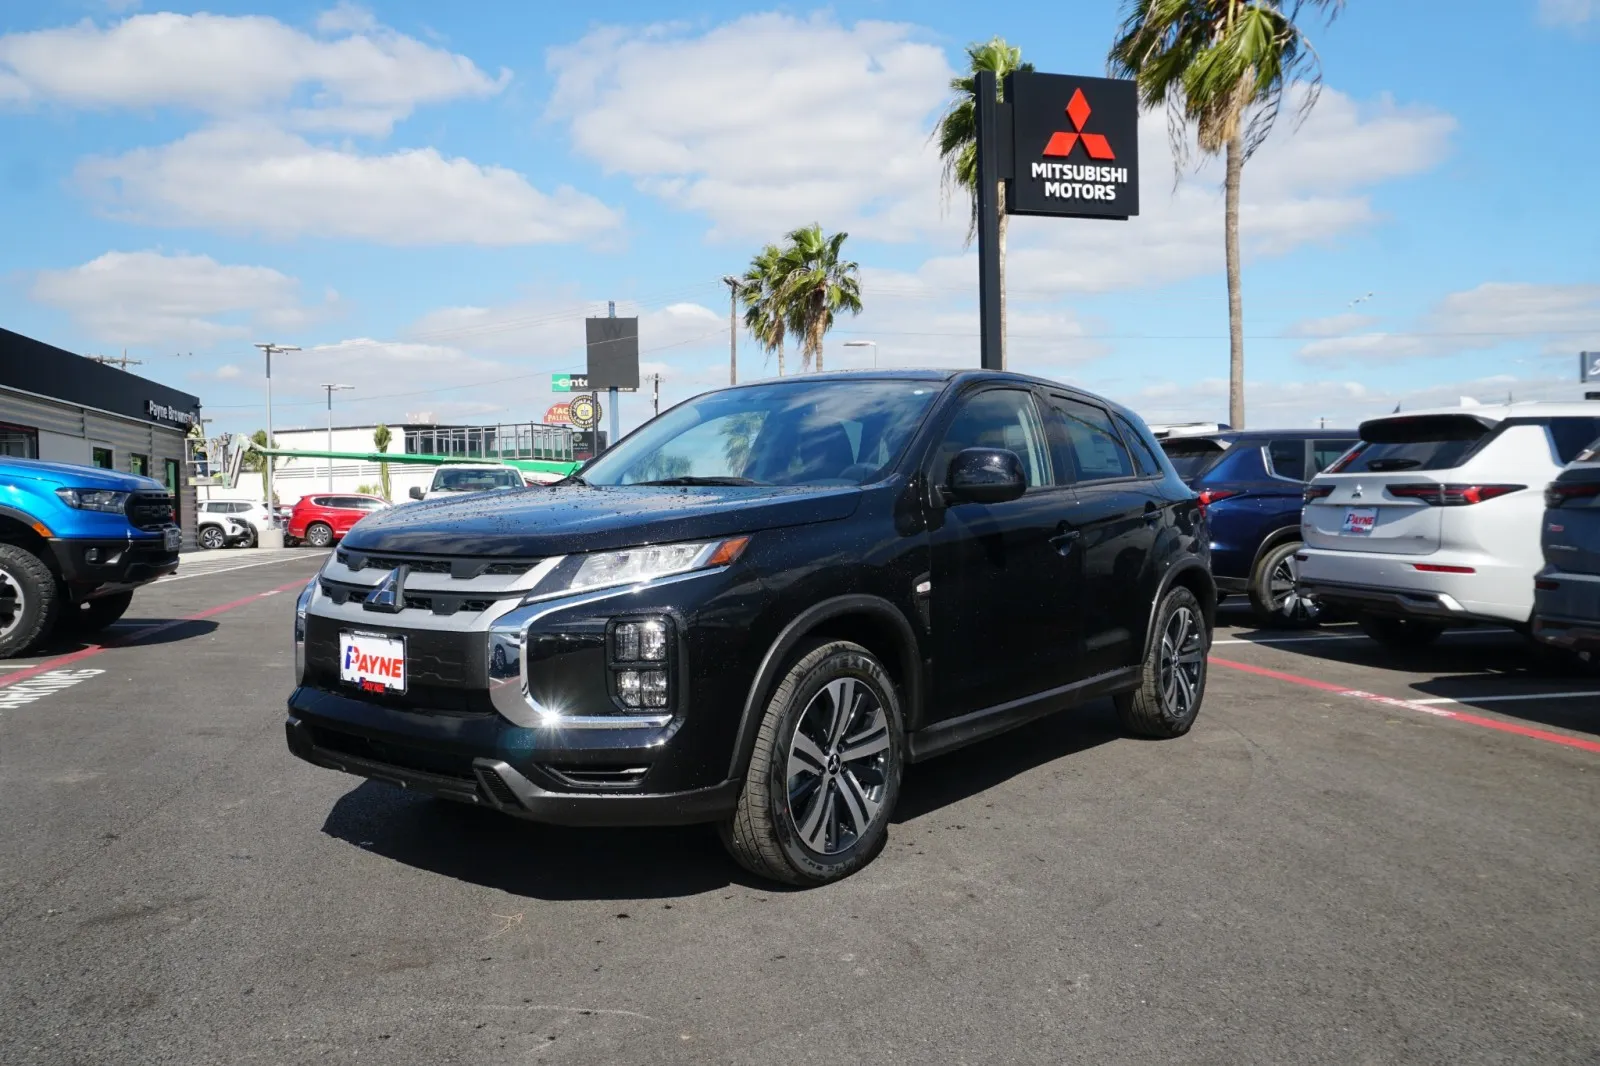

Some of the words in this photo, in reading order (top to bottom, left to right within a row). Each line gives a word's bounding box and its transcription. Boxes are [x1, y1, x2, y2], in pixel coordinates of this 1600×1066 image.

[1031, 162, 1128, 183] MITSUBISHI
[1045, 181, 1116, 200] MOTORS
[149, 400, 168, 420] Payne
[1345, 513, 1375, 526] PAYNE
[345, 645, 403, 678] PAYNE
